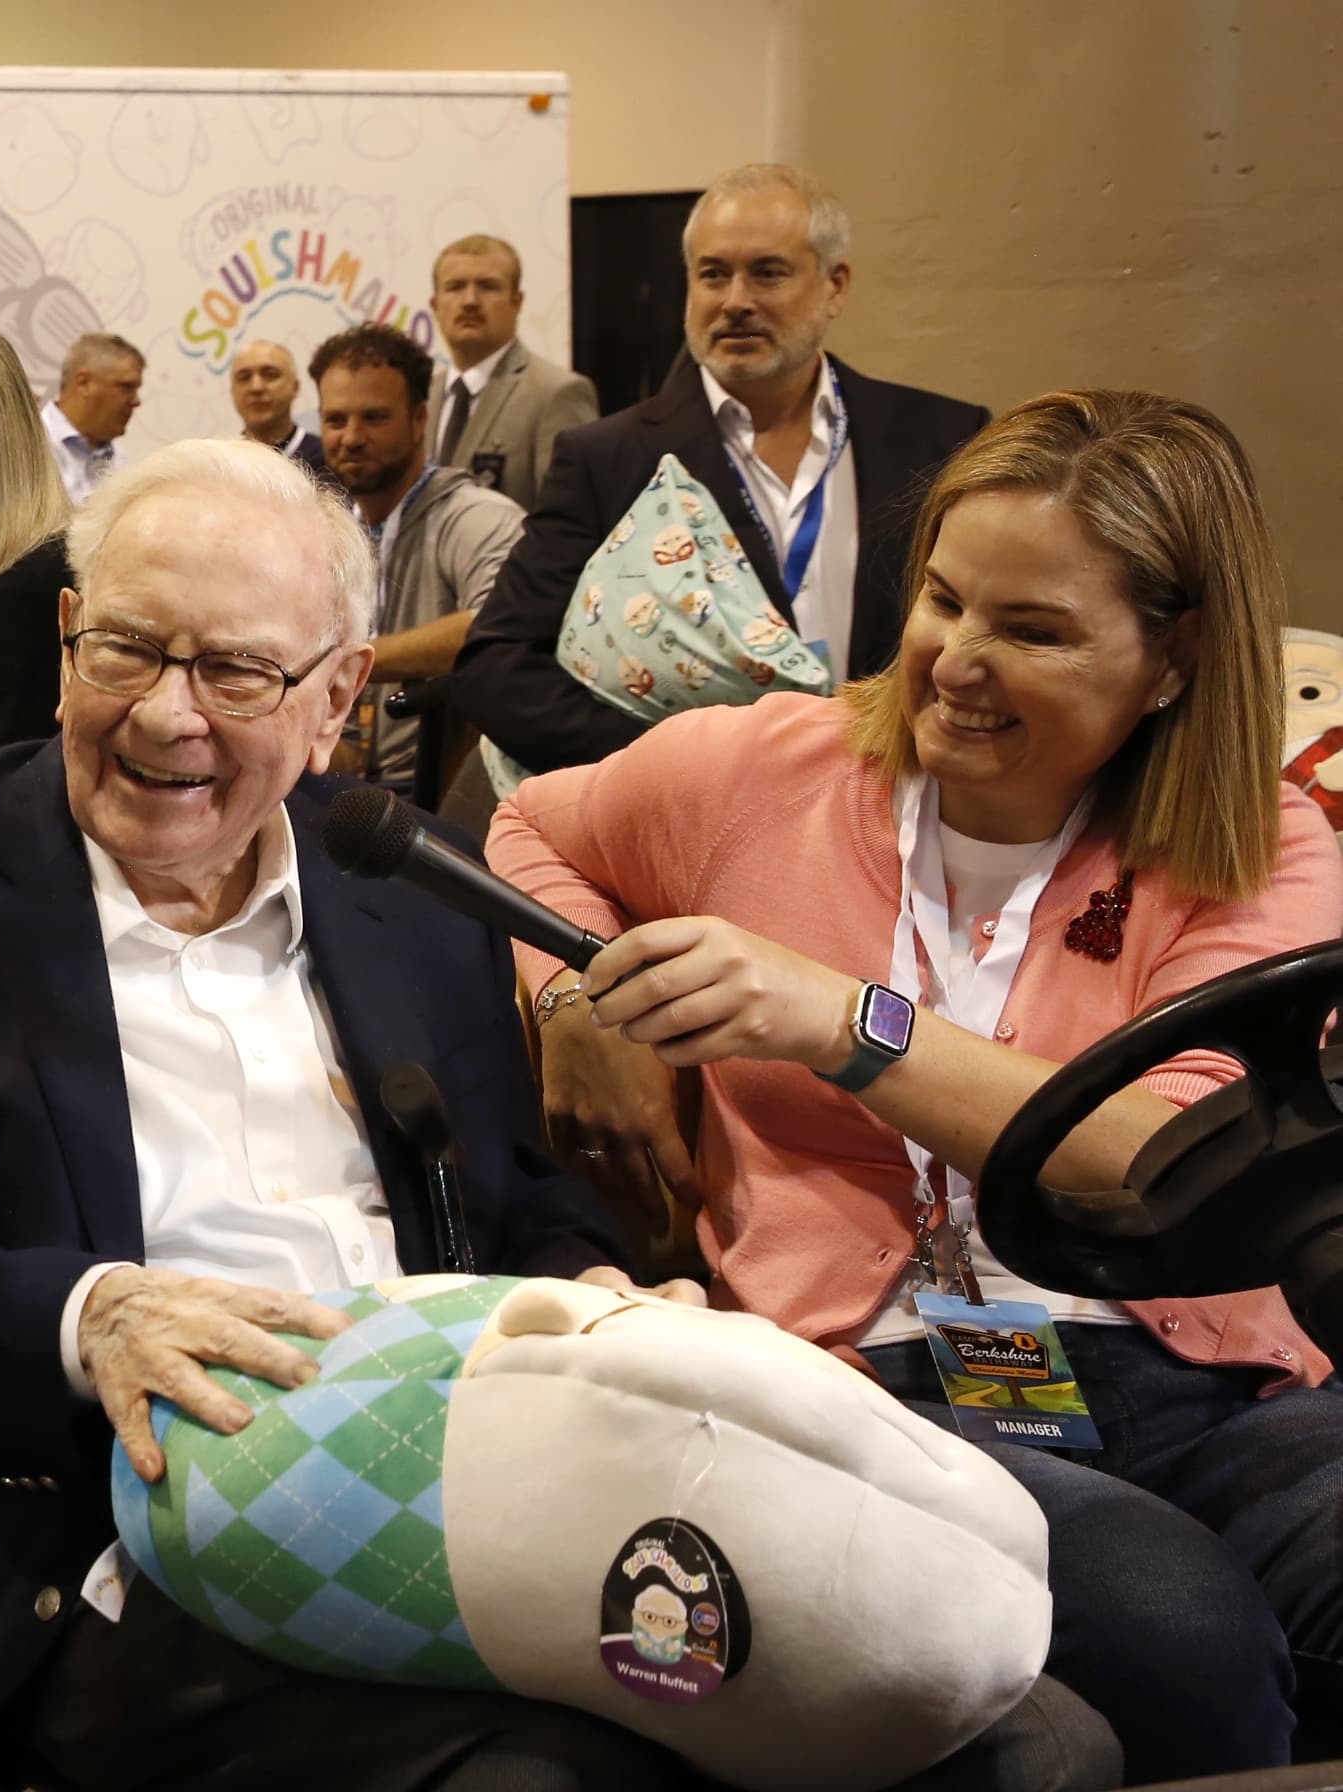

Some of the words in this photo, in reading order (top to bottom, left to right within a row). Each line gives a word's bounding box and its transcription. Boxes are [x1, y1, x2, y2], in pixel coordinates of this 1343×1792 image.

[210, 183, 321, 241] ORIGINAL
[957, 1343, 1042, 1362] Berkshire
[994, 1420, 1063, 1437] MANAGER
[616, 1661, 657, 1682] Warren
[659, 1673, 698, 1693] Buffett
